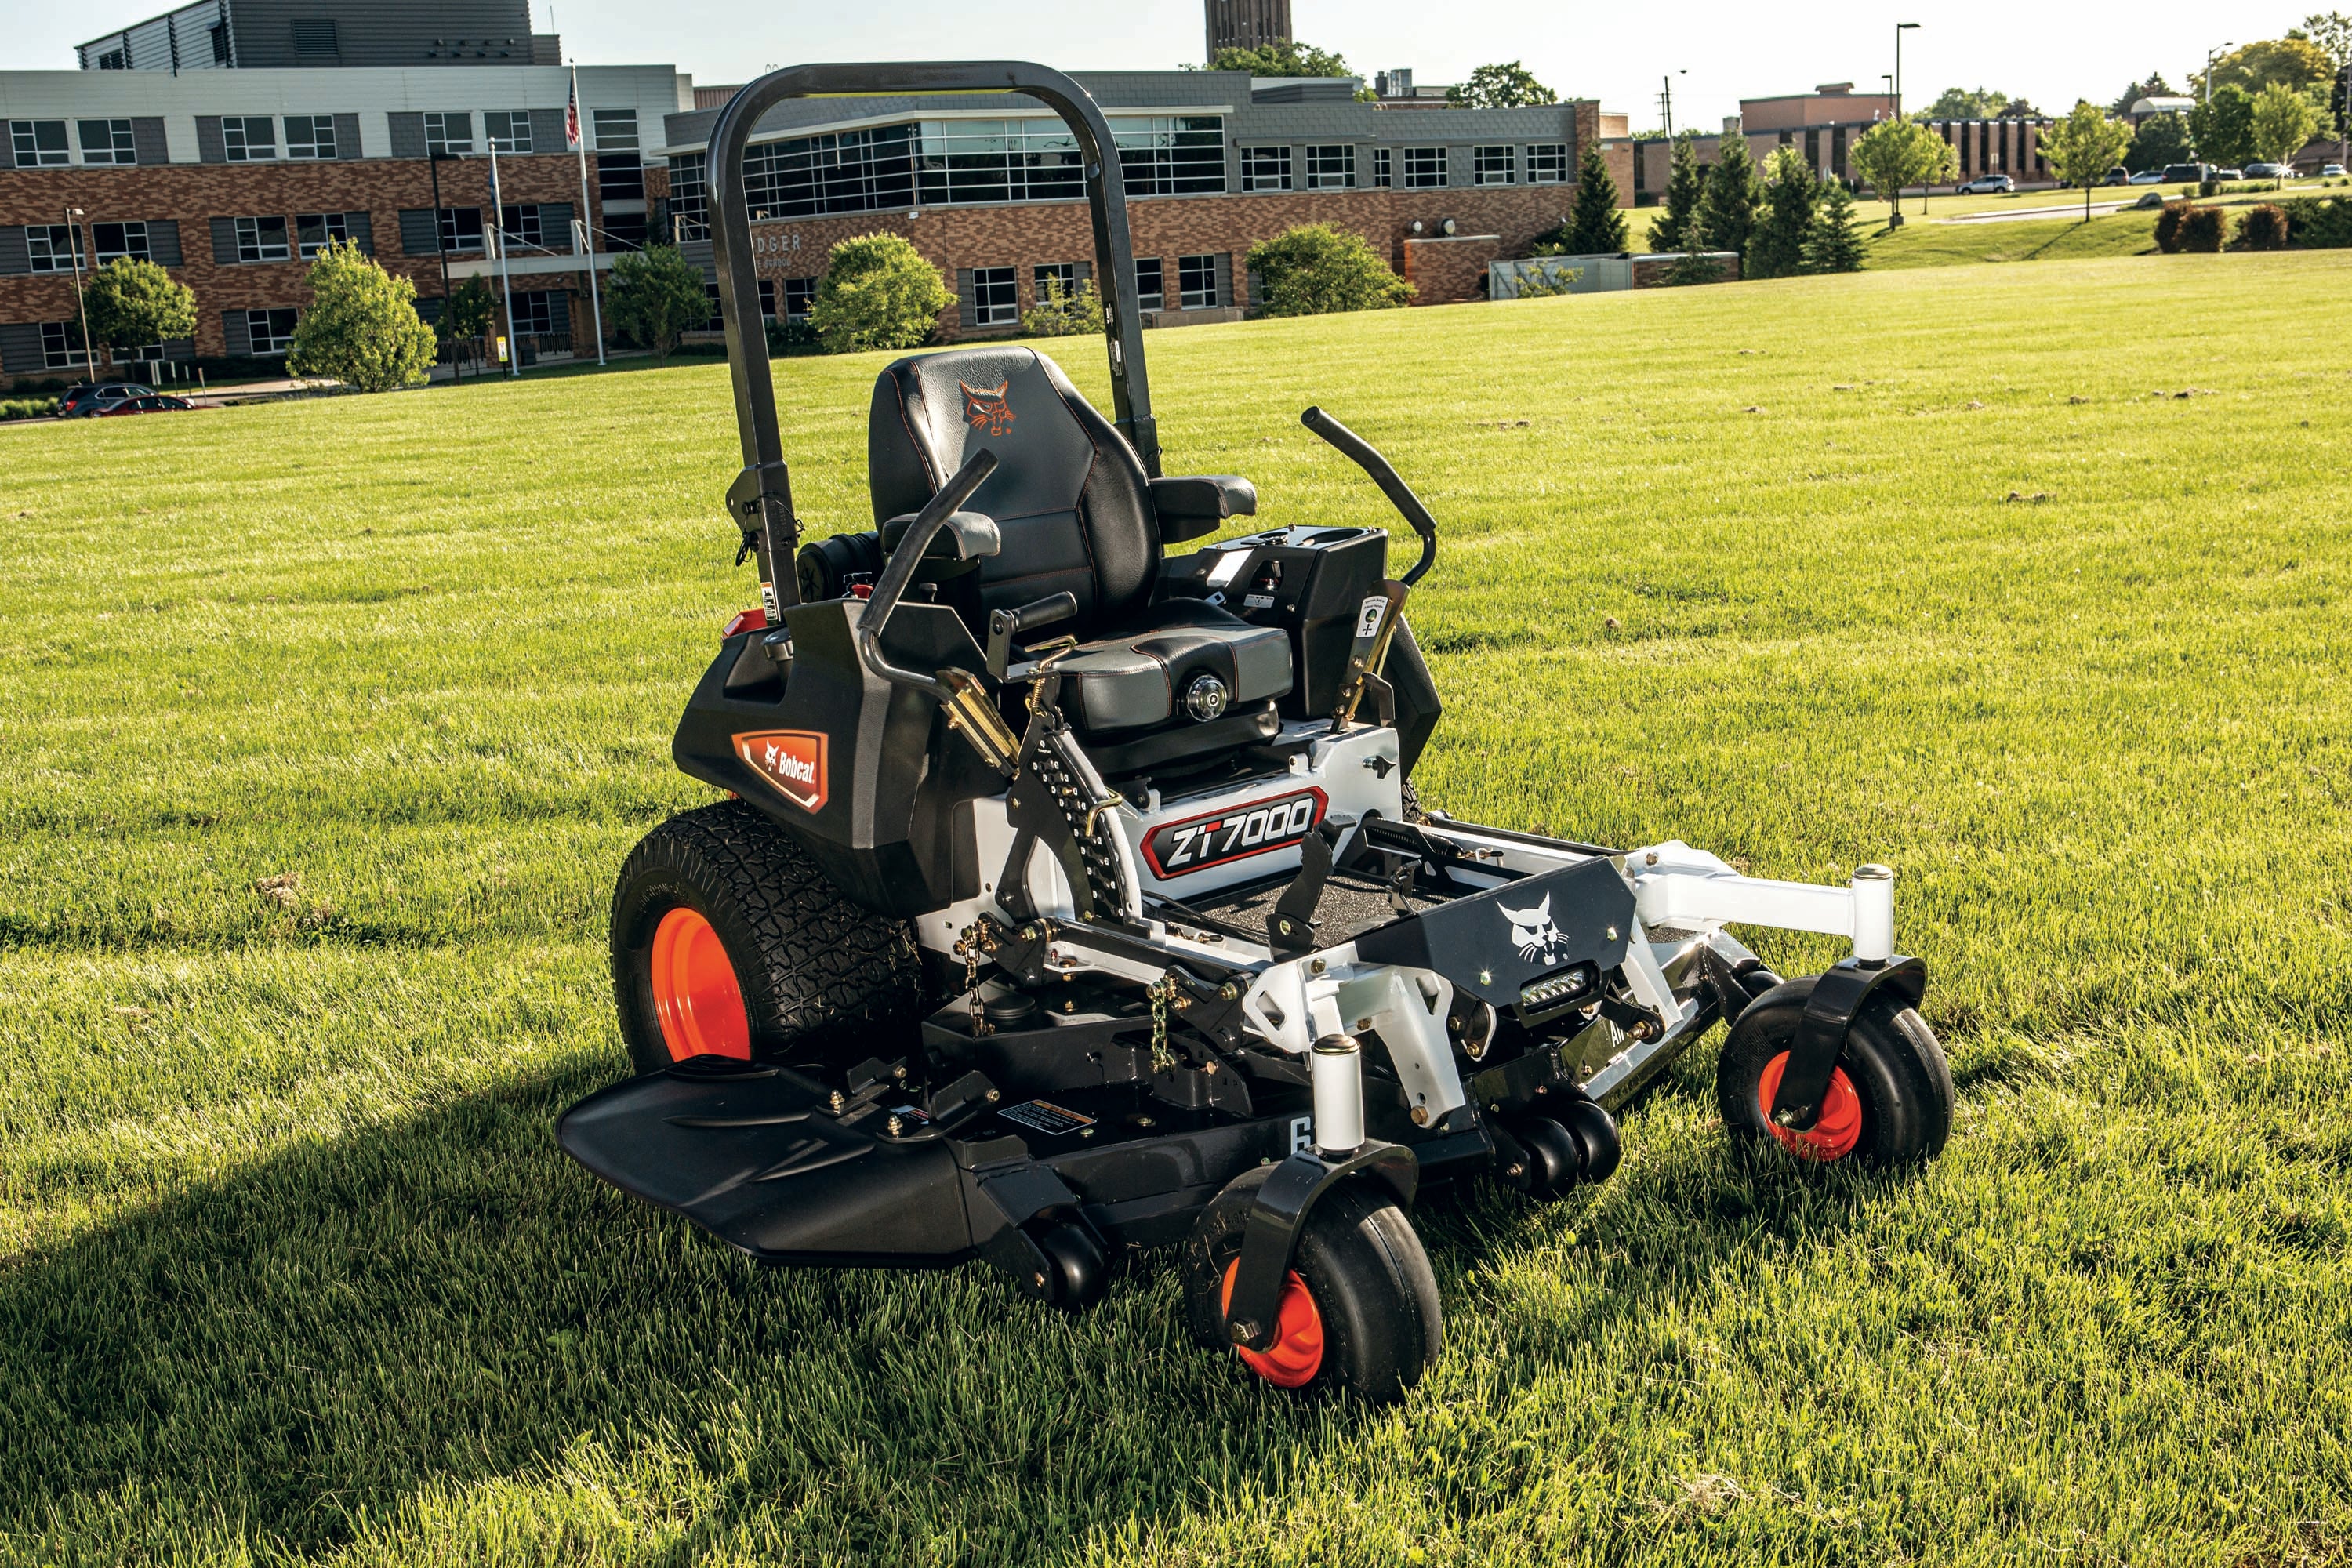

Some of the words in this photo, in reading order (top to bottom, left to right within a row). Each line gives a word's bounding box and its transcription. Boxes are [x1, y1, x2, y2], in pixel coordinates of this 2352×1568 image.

[757, 234, 800, 252] DGER
[779, 750, 814, 785] Bobcat
[1290, 1116, 1311, 1156] 6
